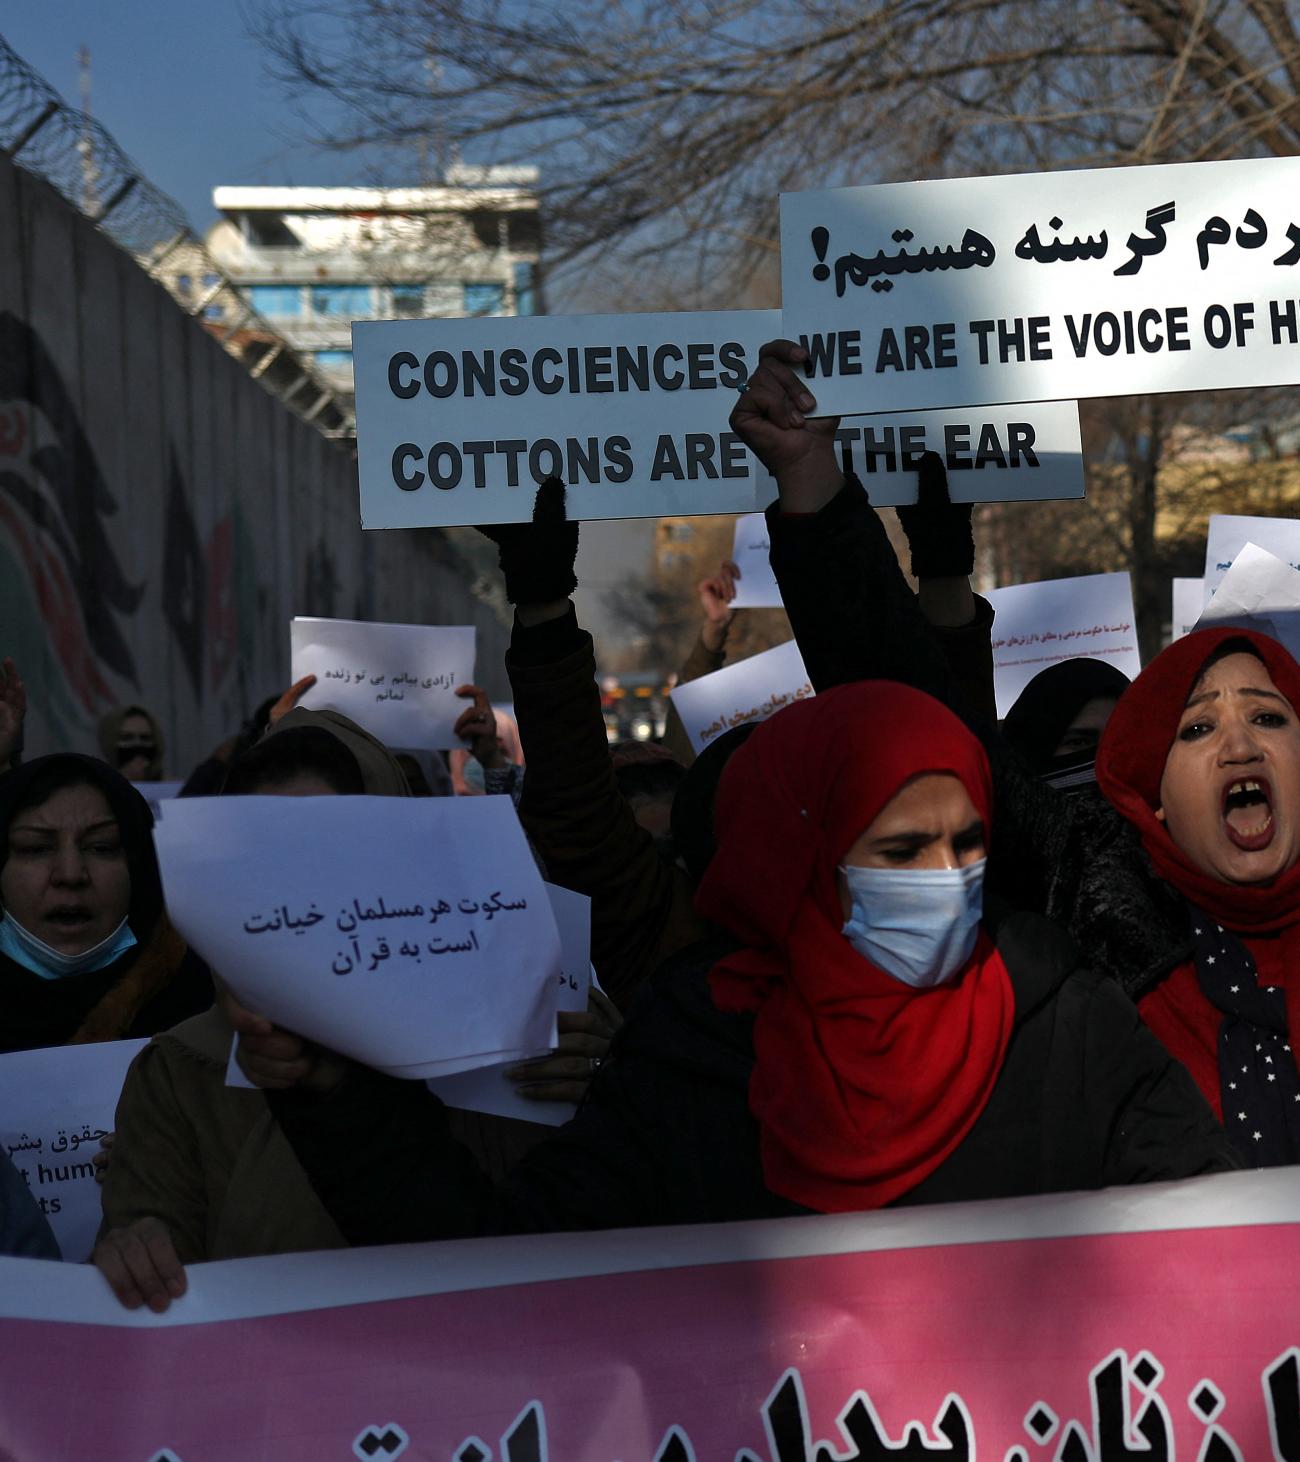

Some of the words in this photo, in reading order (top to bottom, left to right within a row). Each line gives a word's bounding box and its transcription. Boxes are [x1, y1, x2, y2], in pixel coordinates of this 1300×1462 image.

[1015, 200, 1177, 276] گرسنه
[811, 226, 997, 298] هستیم!
[800, 330, 862, 378] WE
[875, 323, 958, 374] ARE
[969, 316, 1054, 365] THE
[1063, 306, 1192, 358] VOICE
[1202, 302, 1256, 349] OF
[388, 342, 749, 400] CONSCIENCES
[391, 434, 634, 492] COTTONS
[650, 432, 750, 481] ARE
[834, 425, 927, 474] THE
[943, 422, 1041, 471] EAR
[325, 667, 351, 684] زنده
[354, 669, 366, 684] تو
[421, 671, 455, 689] آزادی
[375, 687, 405, 703] نمانم
[243, 903, 325, 936] خیانت
[336, 897, 424, 933] مسلمان
[457, 891, 529, 921] سکوت
[331, 935, 391, 976] قرآن
[399, 942, 421, 964] به
[427, 930, 480, 954] است
[51, 1124, 110, 1153] حقوق
[38, 1160, 104, 1185] hum
